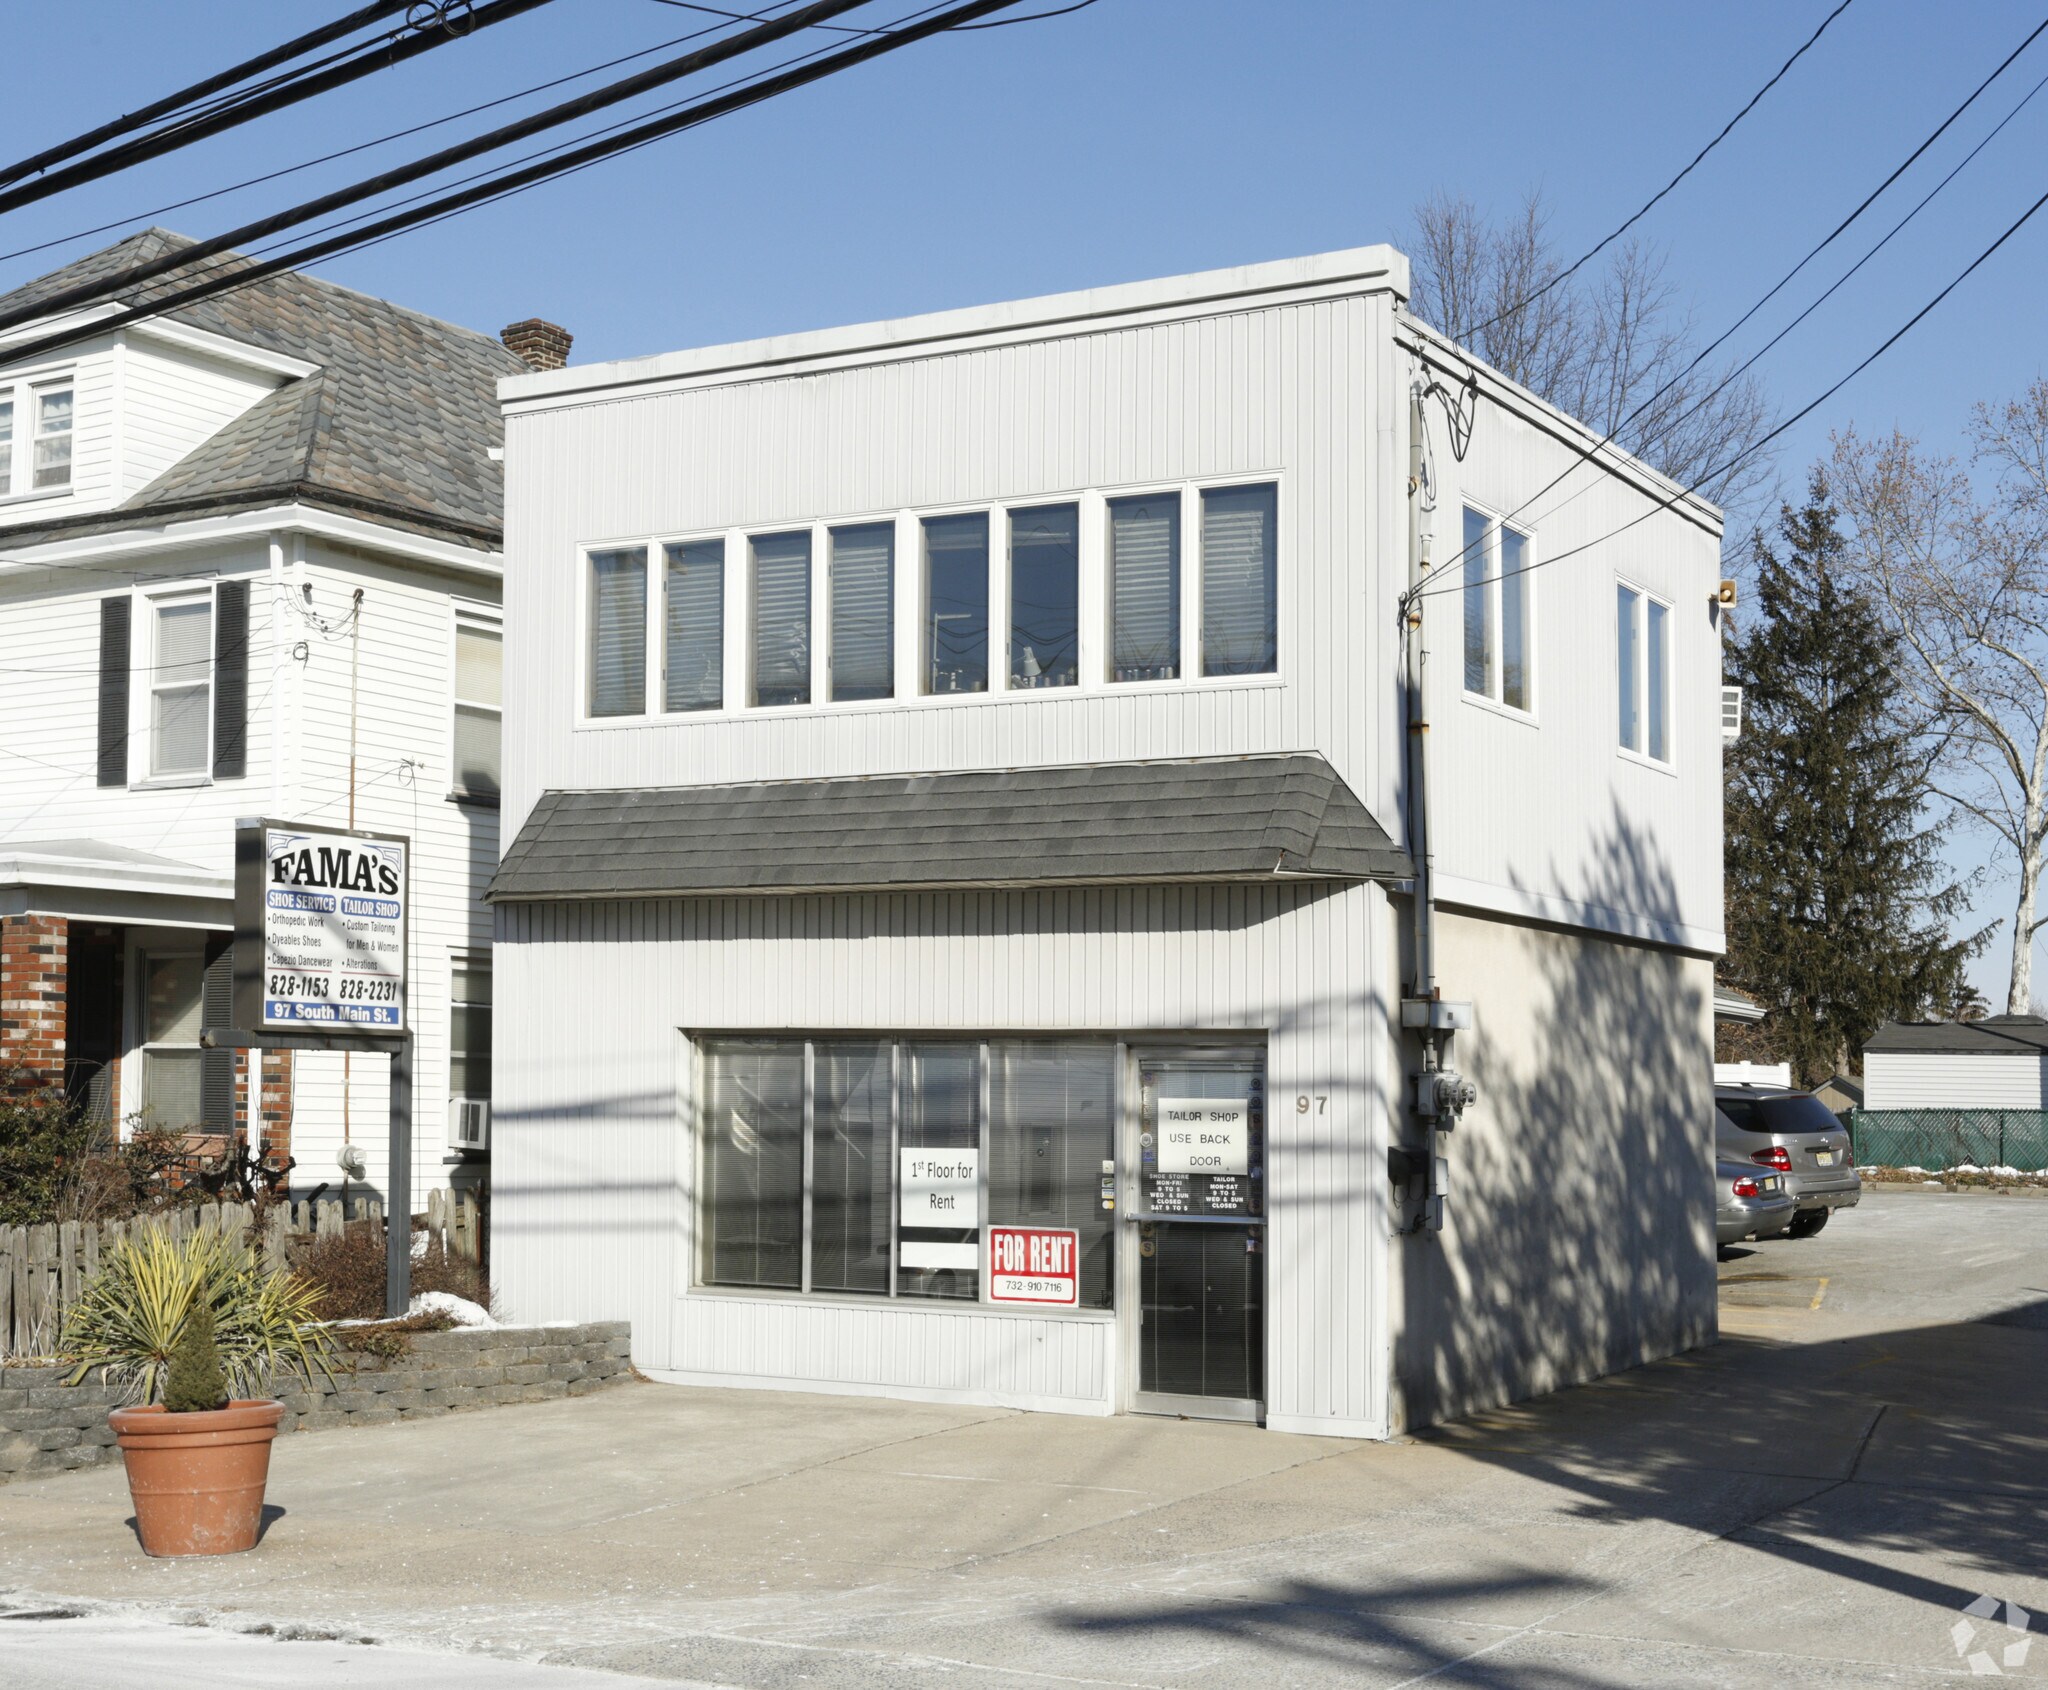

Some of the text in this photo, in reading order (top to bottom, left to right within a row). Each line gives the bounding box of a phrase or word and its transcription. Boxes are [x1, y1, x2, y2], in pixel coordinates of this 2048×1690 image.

[271, 847, 398, 895] FAMA'S
[269, 892, 334, 912] SHOE SERVICE
[344, 898, 398, 917] TAILOR SHOP
[272, 913, 324, 927] Orthopedic Work
[347, 919, 395, 935] Custom Tailoring
[272, 933, 322, 947] Dyeables Shoes
[346, 939, 399, 952] for Men & Women
[272, 953, 332, 967] Capezio Dancewear
[346, 958, 378, 970] Alterations
[270, 974, 329, 997] 828-1153
[340, 979, 397, 1001] 828-2231
[274, 1003, 391, 1023] 97 South Main St.
[1296, 1095, 1327, 1115] 97
[1168, 1110, 1239, 1122] TAILOR SHOP
[1169, 1134, 1231, 1144] USE BACK
[1190, 1156, 1221, 1166] DOOR
[912, 1161, 973, 1178] 1st Floor for
[930, 1193, 955, 1209] Rent
[994, 1234, 1072, 1273] FOR RENT
